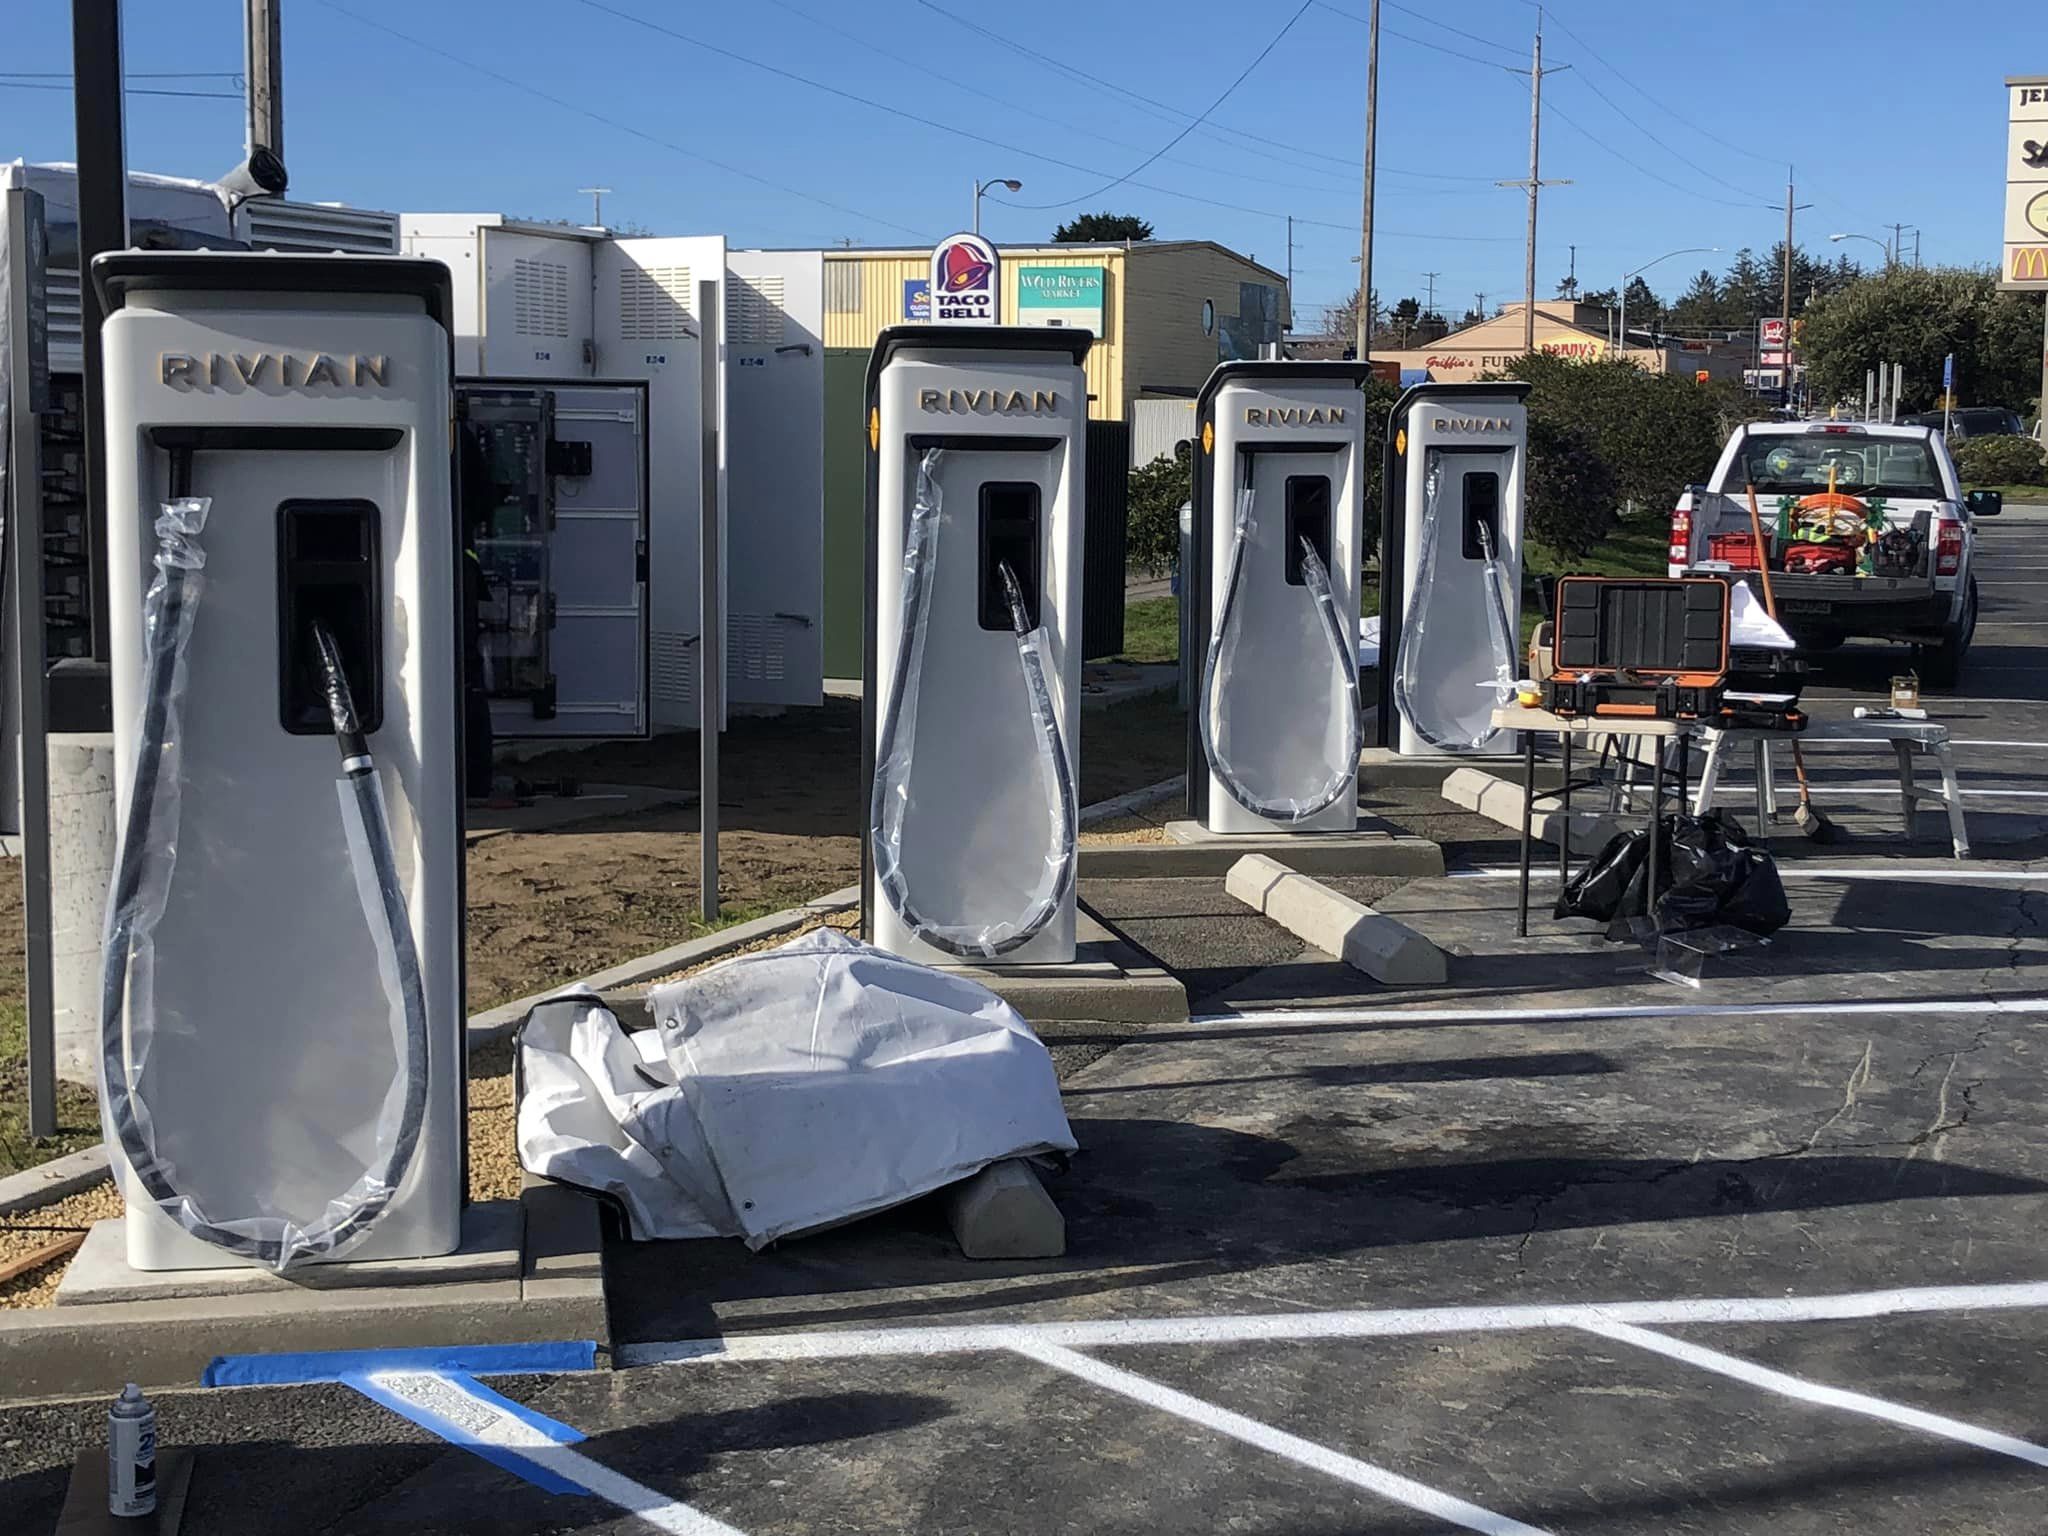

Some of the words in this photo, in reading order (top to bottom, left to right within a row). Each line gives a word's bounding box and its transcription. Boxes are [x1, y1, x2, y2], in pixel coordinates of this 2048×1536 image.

[1058, 274, 1100, 288] RIVERS
[935, 295, 990, 305] TACO
[939, 308, 991, 318] BELL
[160, 352, 392, 387] RIVIAN
[1425, 355, 1474, 370] Griffin's
[919, 388, 1057, 412] RIVIAN
[1245, 408, 1345, 424] RIVIAN
[1432, 418, 1512, 432] RIVIAN
